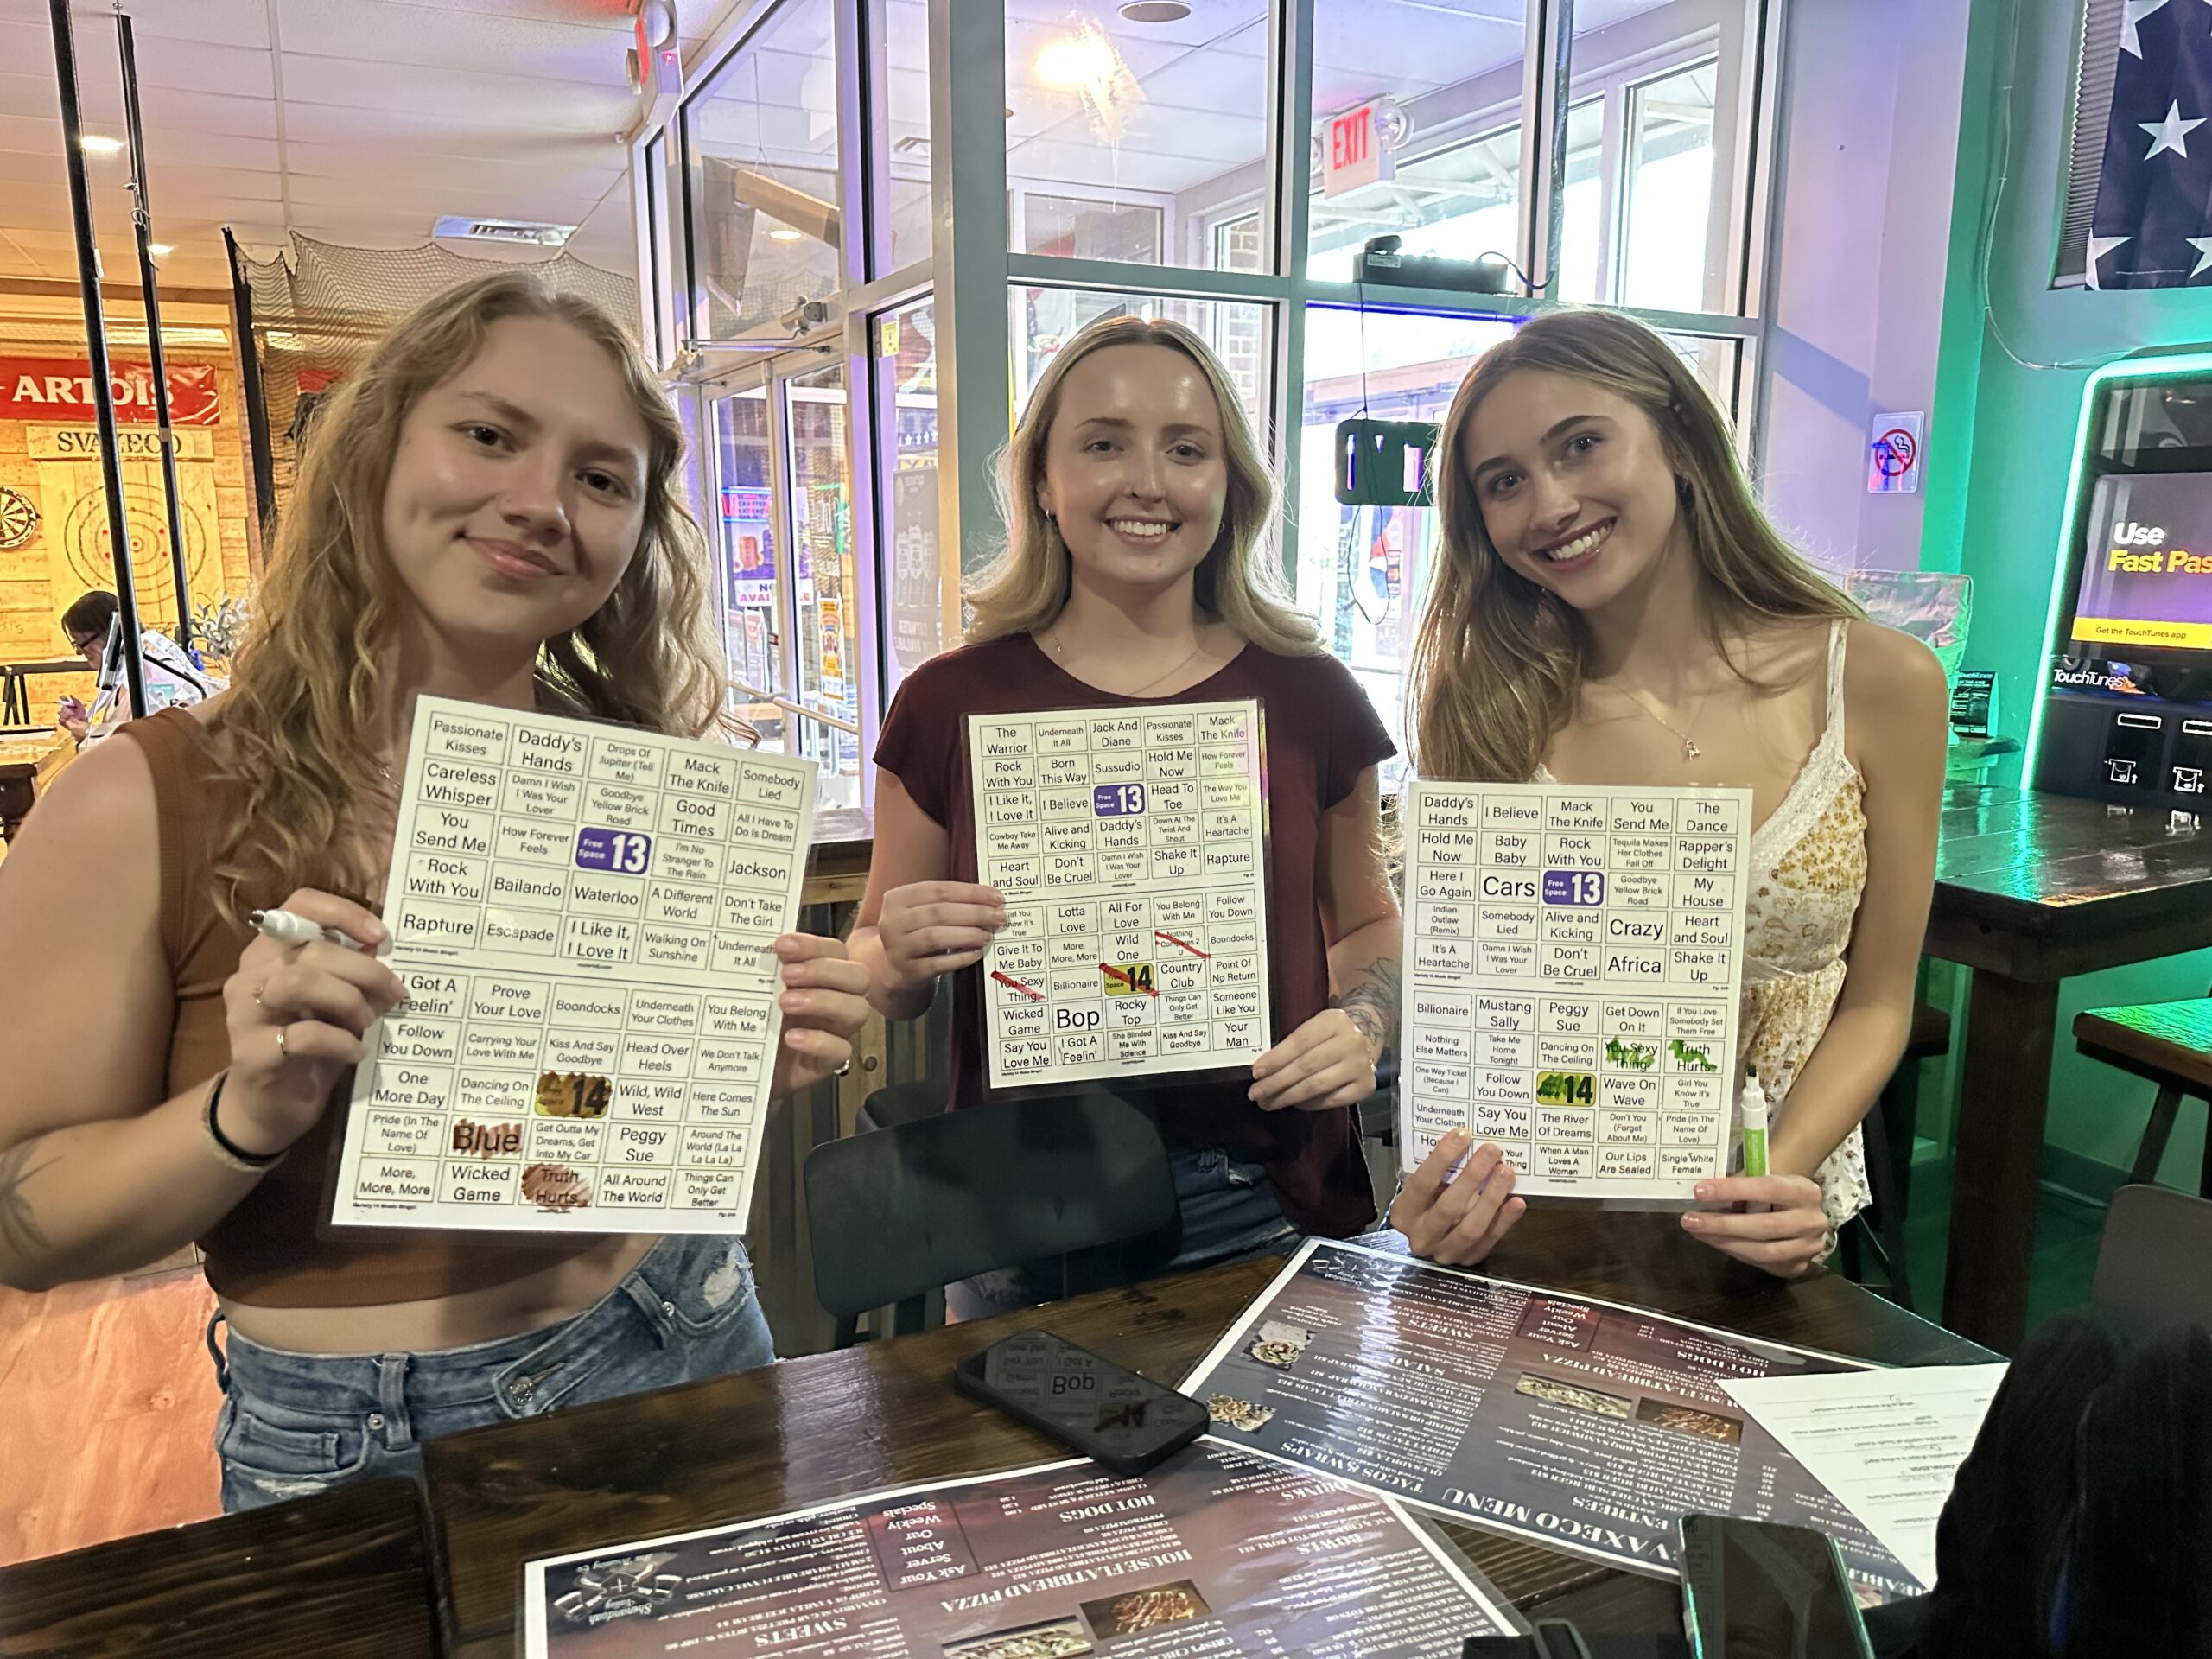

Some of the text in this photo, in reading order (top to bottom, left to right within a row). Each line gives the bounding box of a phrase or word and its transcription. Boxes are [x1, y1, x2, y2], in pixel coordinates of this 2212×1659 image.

[1332, 107, 1370, 171] EXIT
[2113, 522, 2164, 545] Use
[2107, 550, 2164, 573] Fast
[2125, 628, 2169, 638] TouchTunes
[2171, 631, 2186, 639] app
[2053, 669, 2124, 689] TouchTunes
[433, 720, 503, 741] Passionate
[995, 727, 1017, 738] The
[1092, 720, 1138, 733] Jack And
[445, 739, 486, 755] Kisses
[518, 729, 582, 753] Daddy's
[986, 742, 1027, 754] Warrior
[1101, 736, 1131, 747] Diane
[521, 752, 572, 772] Hands
[1095, 760, 1141, 773] Sussudio
[427, 763, 496, 785] Careless
[426, 784, 493, 806] Whisper
[601, 790, 643, 803] Goodbye
[1116, 785, 1142, 813] 13
[592, 799, 648, 815] Yellow Brick
[606, 814, 631, 823] Road
[1217, 814, 1237, 824] It's A
[502, 826, 569, 842] How Forever
[1044, 823, 1090, 836] Alive and
[1205, 826, 1249, 837] Heartache
[520, 842, 547, 855] Feels
[582, 837, 604, 849] Free
[1049, 838, 1086, 850] Kicking
[1495, 835, 1527, 850] Baby
[1678, 840, 1733, 855] Rapper's
[577, 848, 605, 861] Space
[608, 834, 649, 872] 13
[1494, 851, 1527, 865] Baby
[728, 860, 786, 880] Jackson
[1682, 856, 1727, 871] Delight
[493, 876, 562, 897] Bailando
[1483, 875, 1535, 897] Cars
[1570, 873, 1601, 903] 13
[1694, 877, 1714, 892] My
[575, 886, 639, 906] Waterloo
[651, 887, 713, 904] A Different
[1682, 894, 1724, 907] House
[664, 905, 697, 919] World
[1481, 910, 1535, 924] Somebody
[404, 913, 474, 935] Rapture
[486, 923, 554, 941] Escapade
[1497, 925, 1518, 934] Lied
[1610, 918, 1664, 941] Crazy
[1160, 962, 1202, 975] Country
[1216, 957, 1251, 969] Point Of
[1607, 955, 1661, 974] Africa
[1053, 980, 1098, 991] Billionaire
[1126, 964, 1152, 991] 14
[1170, 976, 1194, 988] Club
[1212, 972, 1256, 984] No Return
[556, 999, 620, 1014] Boondocks
[1114, 998, 1147, 1011] Rocky
[1479, 998, 1531, 1015] Mustang
[1605, 1006, 1660, 1018] Get Down
[1059, 1008, 1100, 1028] Bop
[1121, 1014, 1141, 1026] Top
[1490, 1015, 1520, 1029] Sally
[1618, 1021, 1645, 1032] On It
[1679, 1043, 1710, 1055] Truth
[1676, 1059, 1711, 1071] Hurts
[461, 1077, 529, 1093] Dancing On
[620, 1084, 682, 1099] Wild, Wild
[1563, 1075, 1593, 1104] 14
[461, 1092, 524, 1109] The Ceiling
[567, 1077, 609, 1116] 14
[632, 1103, 664, 1116] West
[1541, 1113, 1589, 1124] The River
[453, 1125, 521, 1152] Blue
[620, 1127, 667, 1145] Peggy
[1538, 1126, 1592, 1138] Of Dreams
[625, 1147, 654, 1162] Sue
[1605, 1151, 1647, 1163] Our Lips
[451, 1165, 511, 1181] Wicked
[1599, 1164, 1651, 1174] Are Sealed
[453, 1186, 501, 1202] Game
[1543, 1306, 1586, 1319] Weekly
[1547, 1299, 1590, 1313] Specials
[1541, 1319, 1577, 1332] About
[1551, 1314, 1573, 1324] Our
[1408, 1319, 1474, 1339] SWEETS
[1538, 1326, 1575, 1339] Server
[1527, 1332, 1580, 1348] Ask Your
[1389, 1357, 1446, 1376] SALAD
[1542, 1353, 1590, 1370] PIZZA
[1676, 1350, 1765, 1378] HOT DOGS
[1592, 1364, 1696, 1398] FLATBREAD
[1376, 1432, 1410, 1446] TACOS
[1281, 1441, 1423, 1493] TACOS & WRAPS
[1376, 1452, 1442, 1476] QUESADILLA
[882, 1501, 936, 1518] Specials
[1059, 1494, 1156, 1522] HOT DOGS
[1571, 1496, 1669, 1529] ENTREES
[887, 1513, 941, 1531] Weekly
[1441, 1487, 1678, 1562] VAXECO MENU
[905, 1529, 933, 1541] Our
[900, 1540, 944, 1557] About
[1295, 1533, 1363, 1555] BOWLS
[906, 1553, 952, 1569] Server
[899, 1564, 966, 1586] Ask Your
[940, 1548, 1192, 1612] HOUSE FLATBREAD PIZZA
[588, 1603, 652, 1626] Shenandoah
[753, 1616, 847, 1648] SWEETS
